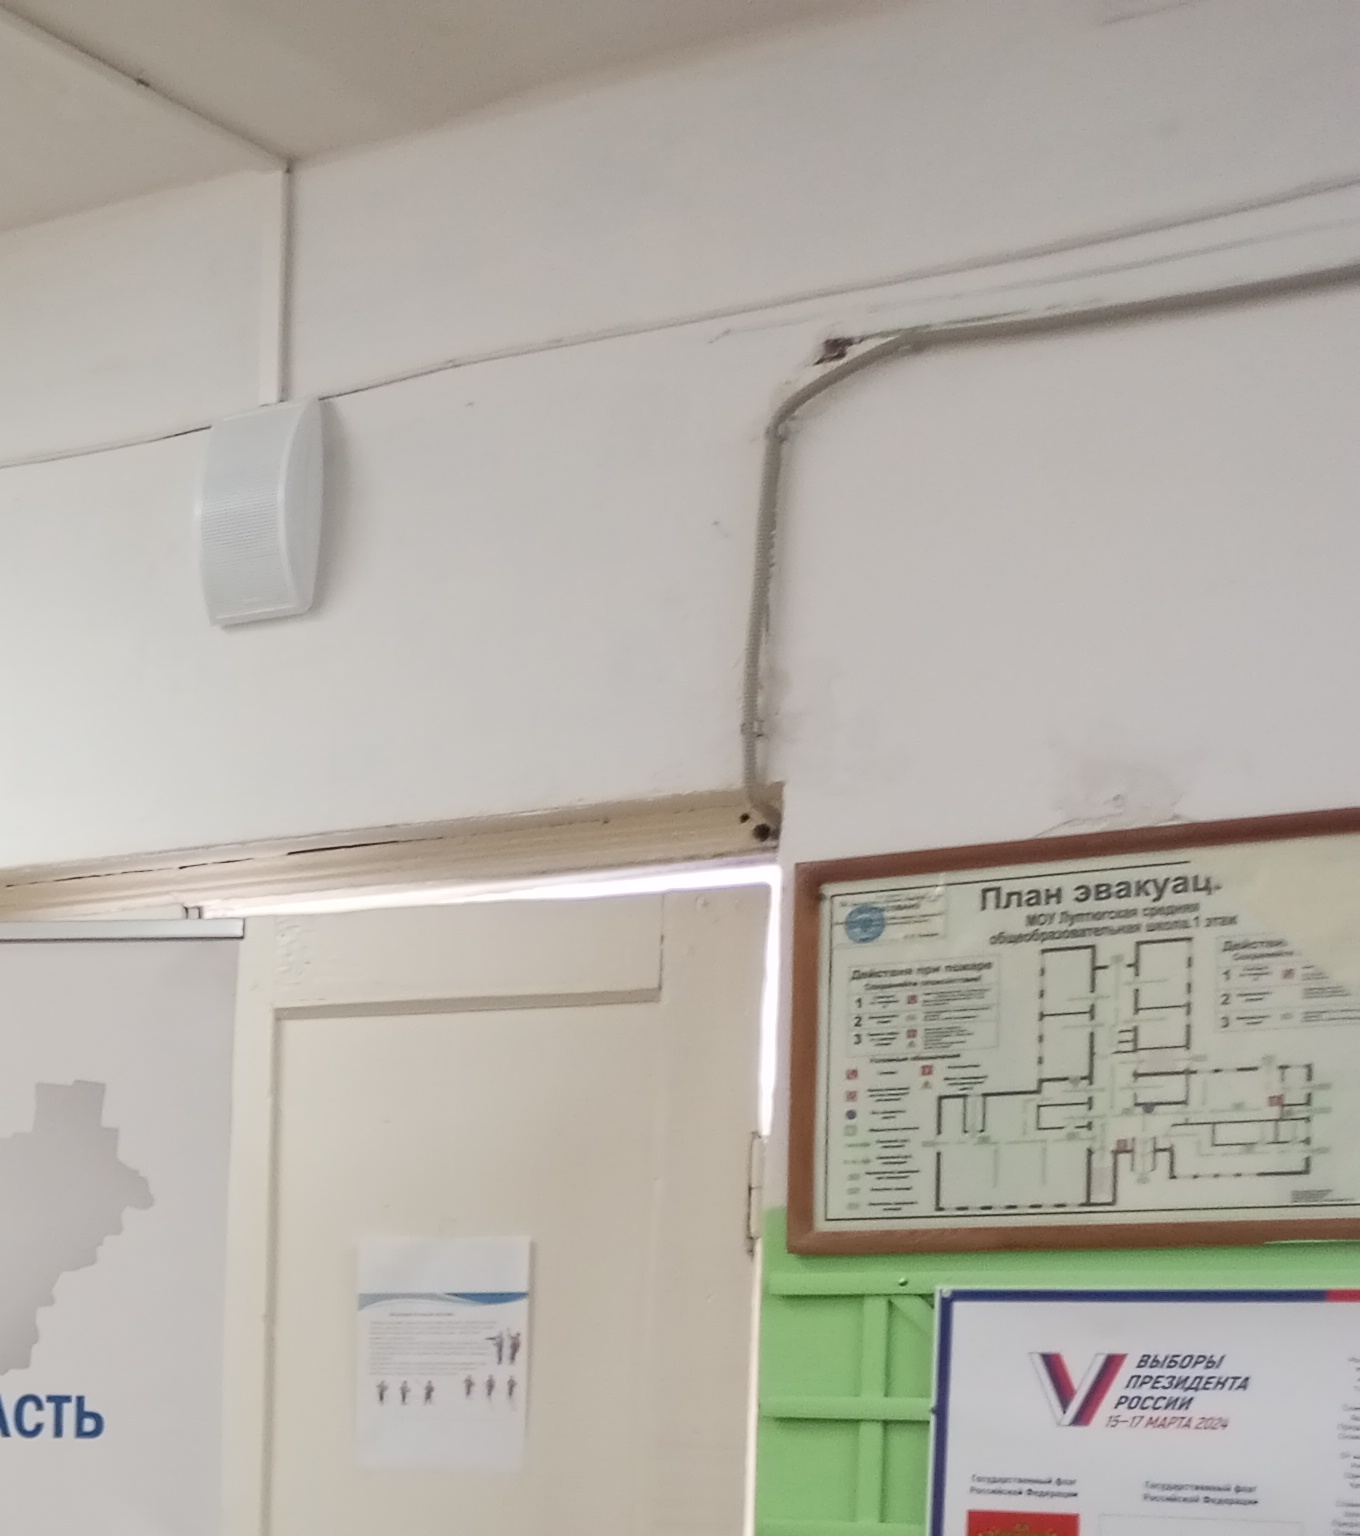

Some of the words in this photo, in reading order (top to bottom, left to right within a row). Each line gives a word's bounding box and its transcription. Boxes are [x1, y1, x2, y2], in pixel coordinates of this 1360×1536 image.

[980, 886, 1062, 912] План
[1073, 874, 1222, 903] эвакуац
[853, 1016, 863, 1028] 2
[853, 1034, 863, 1046] 3
[1136, 1353, 1226, 1370] ВЫБОРЫ
[1125, 1375, 1251, 1392] ПРЕЗИДЕНТА
[1114, 1395, 1194, 1411] РОССИИ
[1144, 1416, 1191, 1430] МАРТА
[1192, 1417, 1230, 1431] 2024
